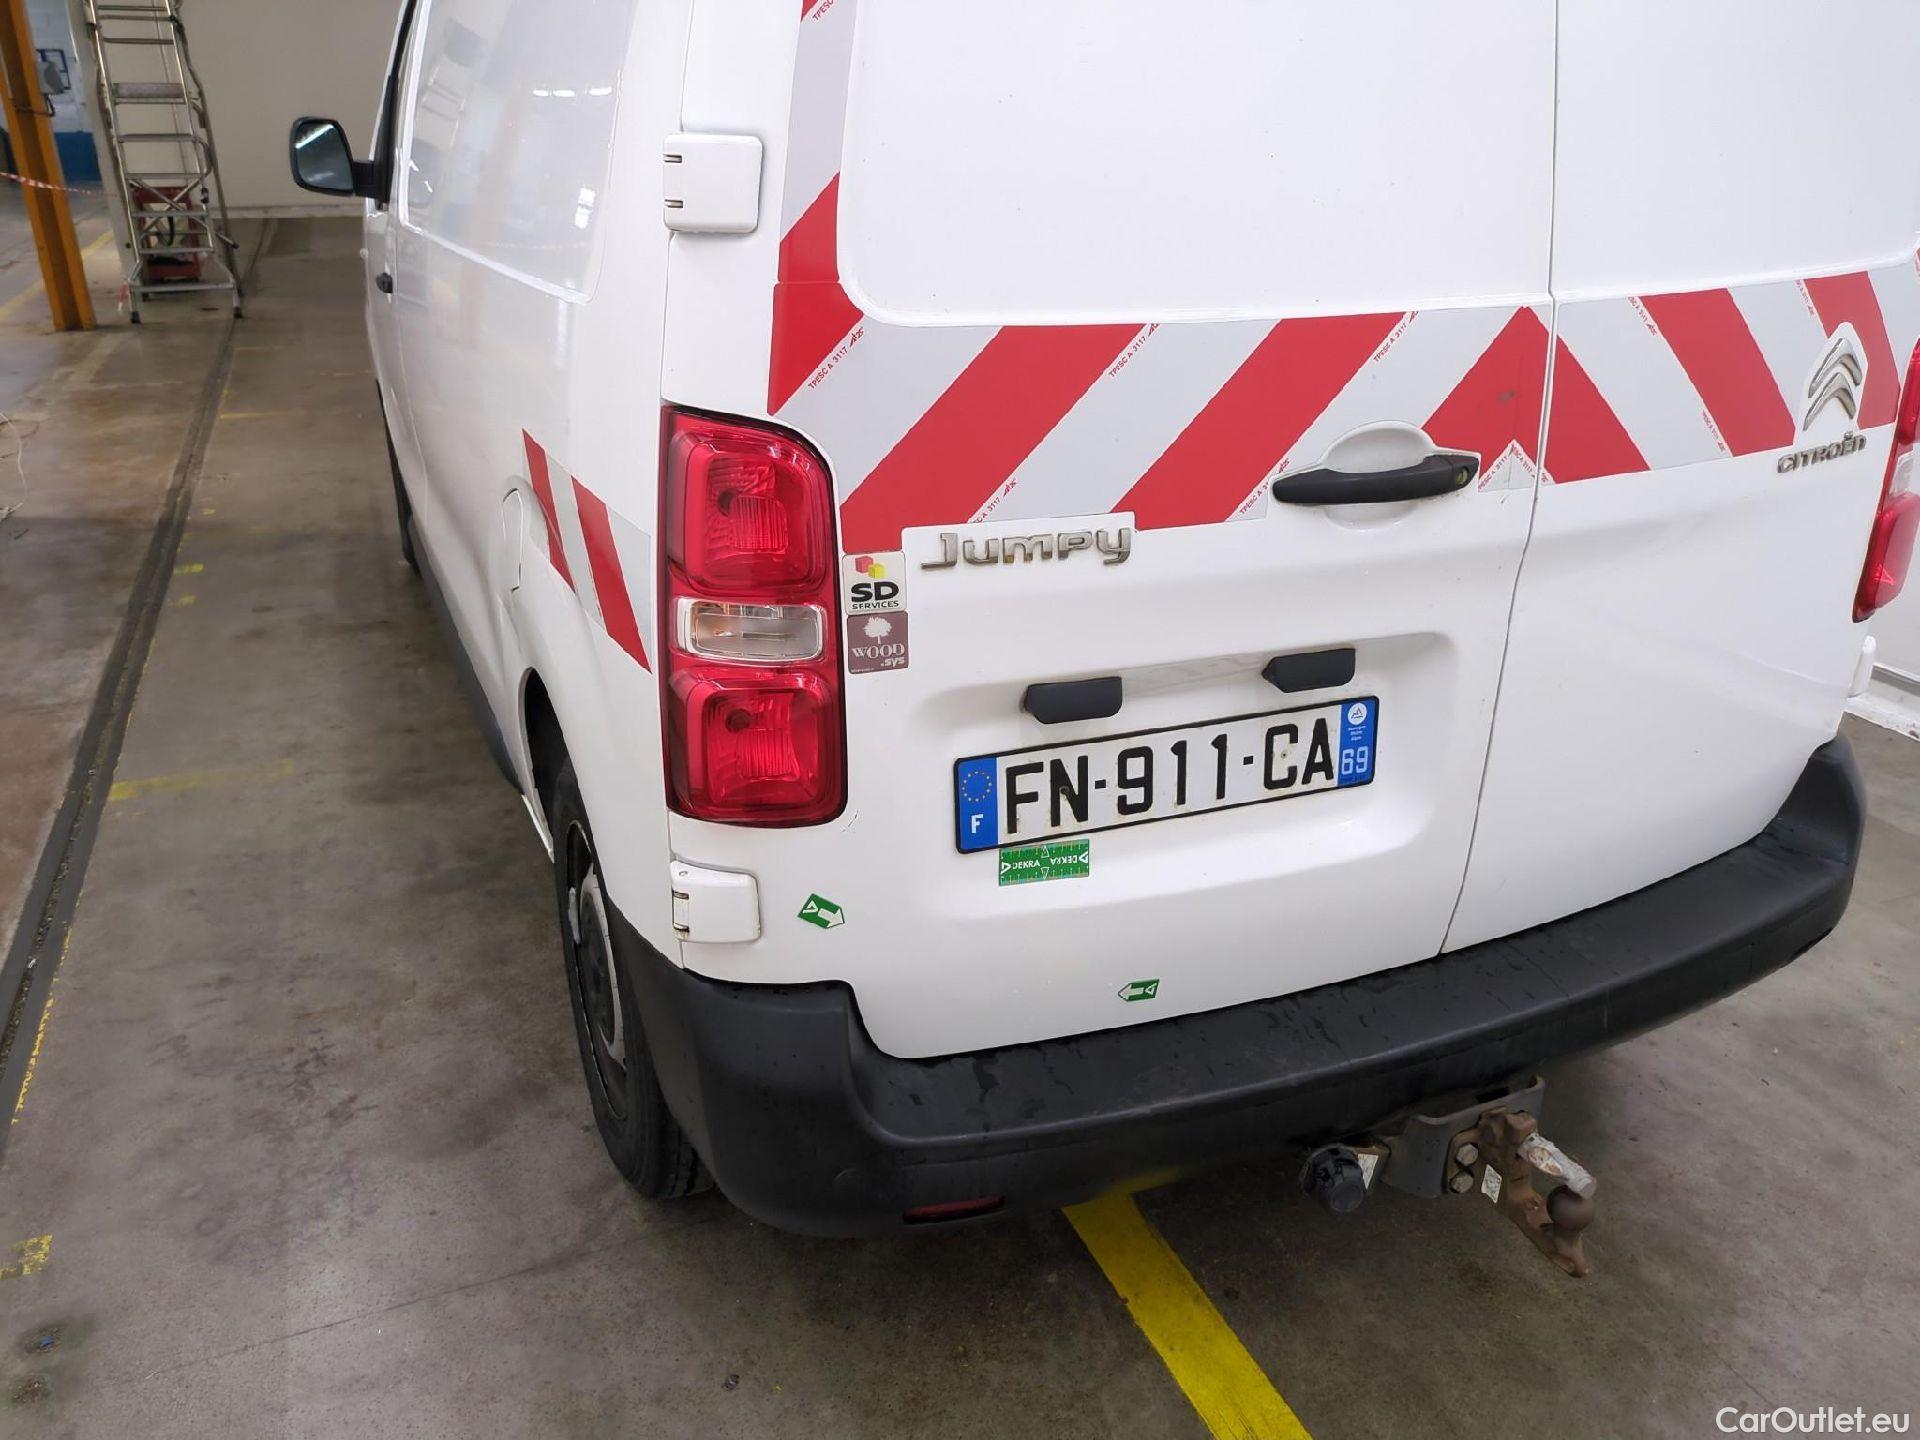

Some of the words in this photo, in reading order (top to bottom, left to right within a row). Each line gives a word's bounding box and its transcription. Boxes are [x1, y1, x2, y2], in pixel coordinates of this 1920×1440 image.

[807, 367, 829, 389] TPESC
[827, 362, 834, 370] A
[832, 345, 848, 363] 3117
[1108, 356, 1129, 378] TPESC
[1132, 335, 1146, 352] 3117
[986, 496, 1001, 512] 3117
[920, 527, 1132, 570] Jumpy
[850, 581, 900, 602] SD
[852, 600, 899, 610] SERVICES
[851, 643, 905, 659] WOOD
[1341, 745, 1369, 775] 69
[1005, 717, 1335, 835] FN-911-CA
[970, 813, 984, 834] F
[1012, 859, 1041, 870] DEKRA
[1049, 854, 1079, 866] DEKRA
